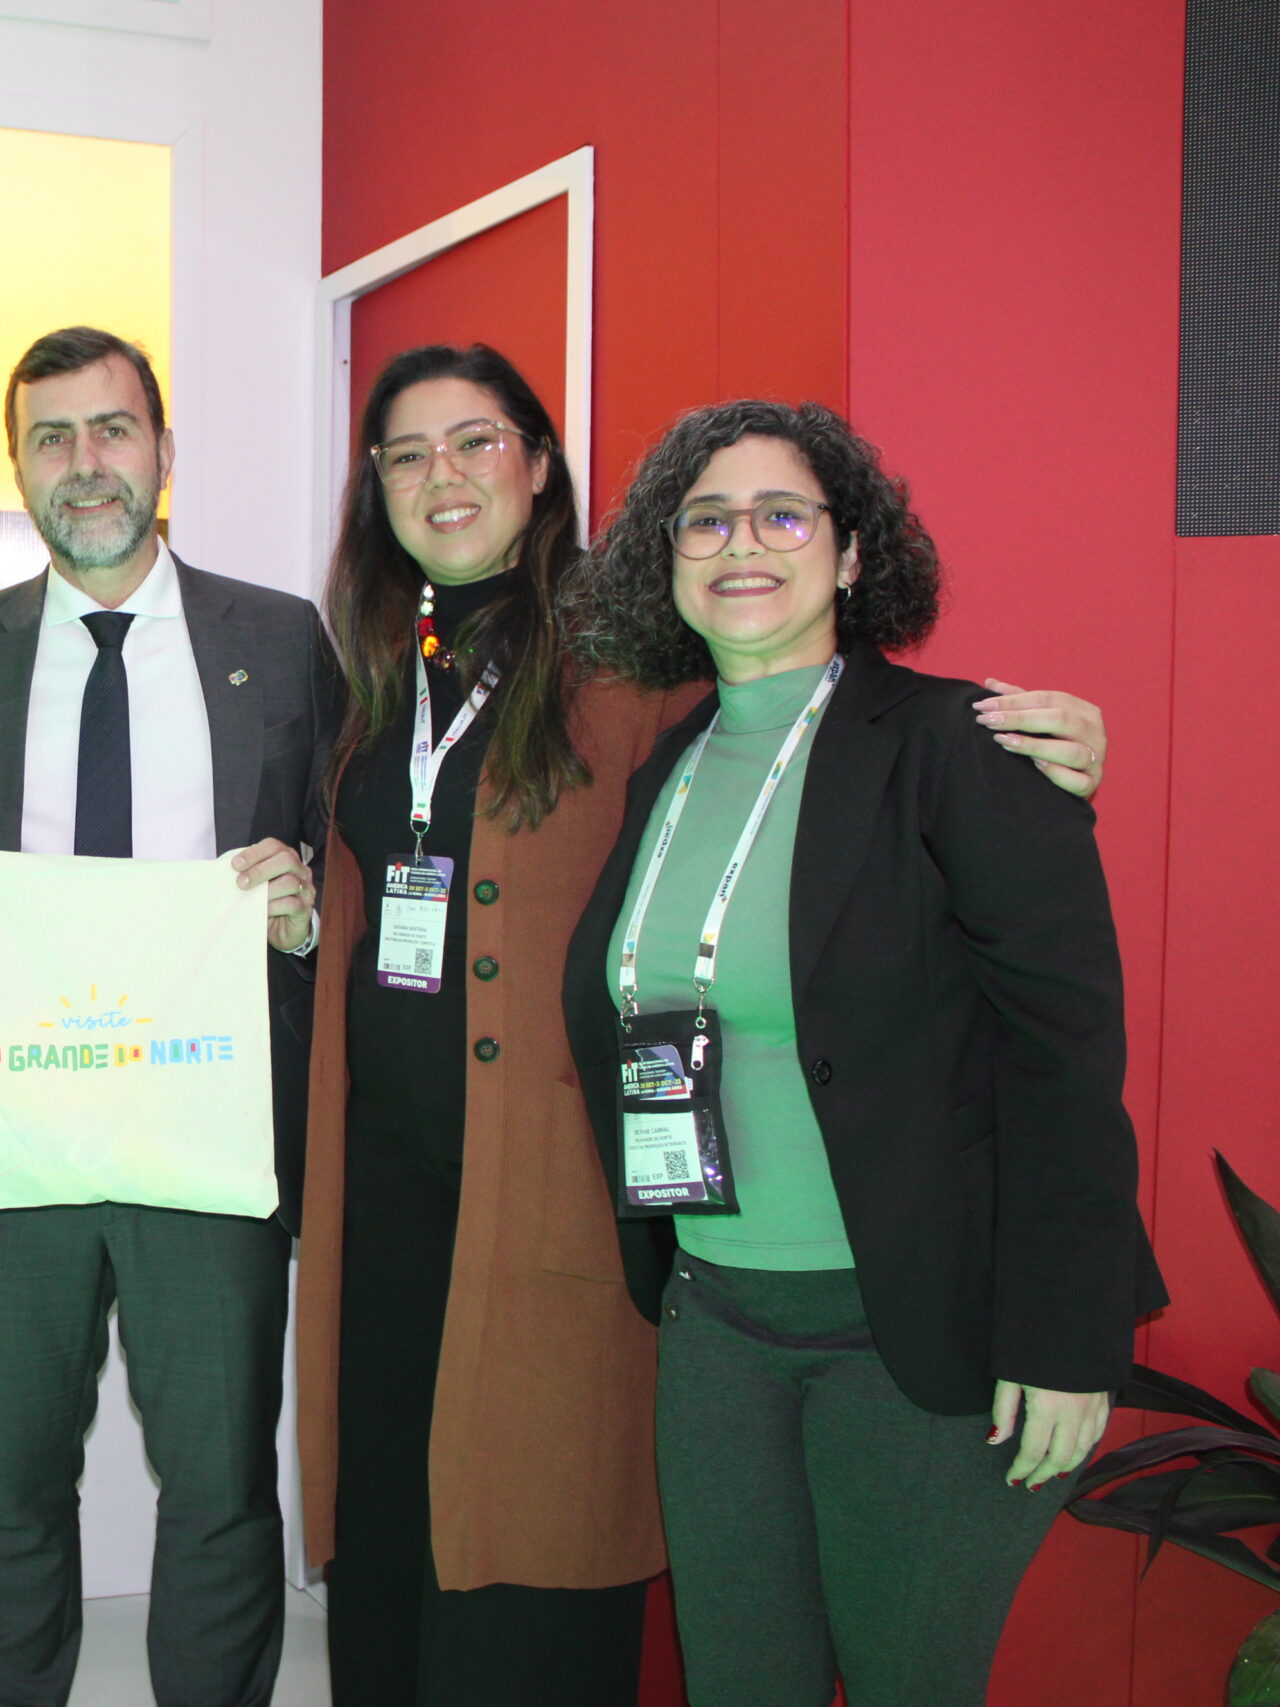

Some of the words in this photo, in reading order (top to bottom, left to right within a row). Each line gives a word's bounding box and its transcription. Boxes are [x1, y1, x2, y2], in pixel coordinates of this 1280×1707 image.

[719, 862, 738, 897] expan
[387, 975, 428, 989] EXPOSITOR
[62, 1010, 132, 1030] visite
[8, 1043, 109, 1072] GRANDE
[114, 1043, 143, 1067] DO
[150, 1036, 233, 1065] NORTE
[638, 1187, 690, 1200] EXPOSITOR
